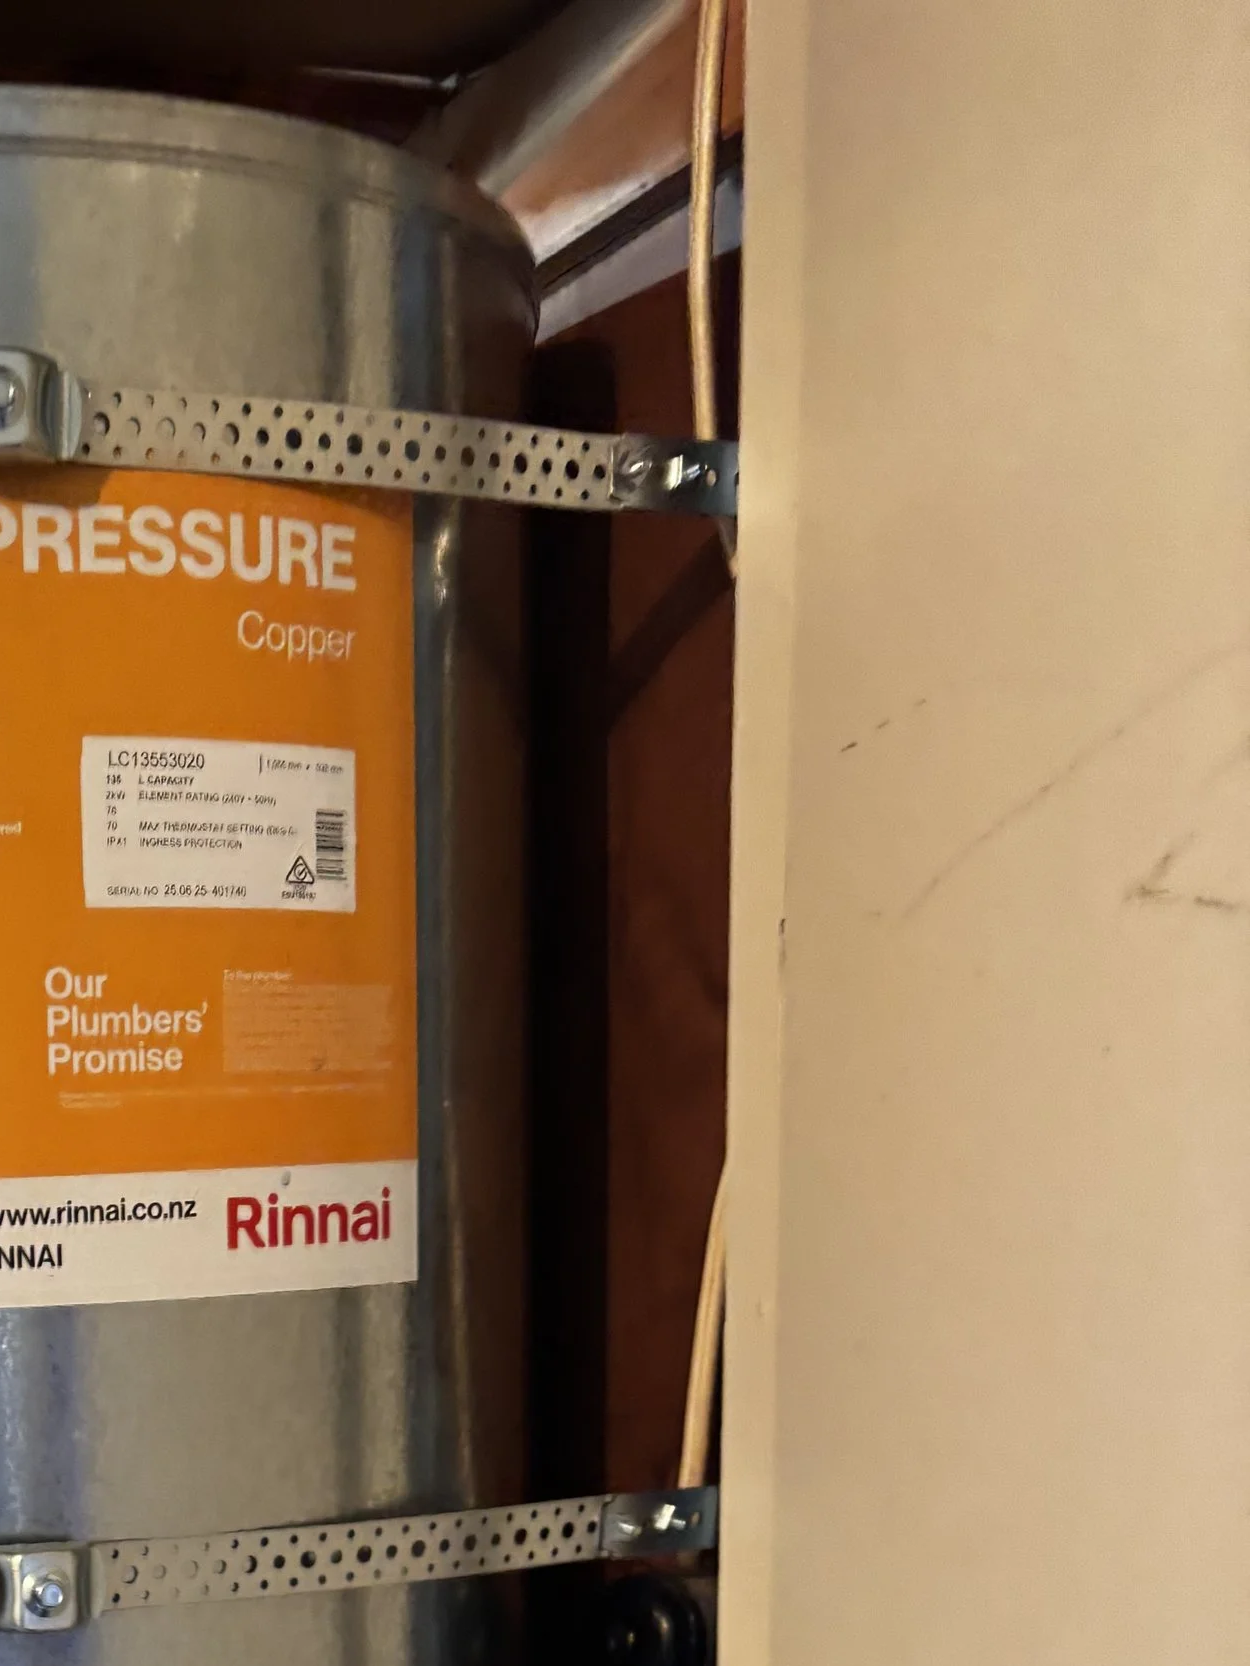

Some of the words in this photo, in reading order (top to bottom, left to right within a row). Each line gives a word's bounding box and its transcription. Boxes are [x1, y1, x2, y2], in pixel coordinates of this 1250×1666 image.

[237, 610, 356, 661] Copper
[108, 750, 205, 769] LC13553020
[147, 775, 195, 786] CAPACITY
[138, 791, 184, 802] ELEMENT
[185, 792, 220, 803] RATING
[139, 837, 183, 848] INGRESS
[184, 838, 242, 850] PROTECTION
[107, 886, 142, 897] SERIAL
[143, 886, 159, 896] NO
[45, 965, 108, 1000] Our
[48, 1041, 184, 1076] Promise
[226, 1187, 392, 1250] Rinnai
